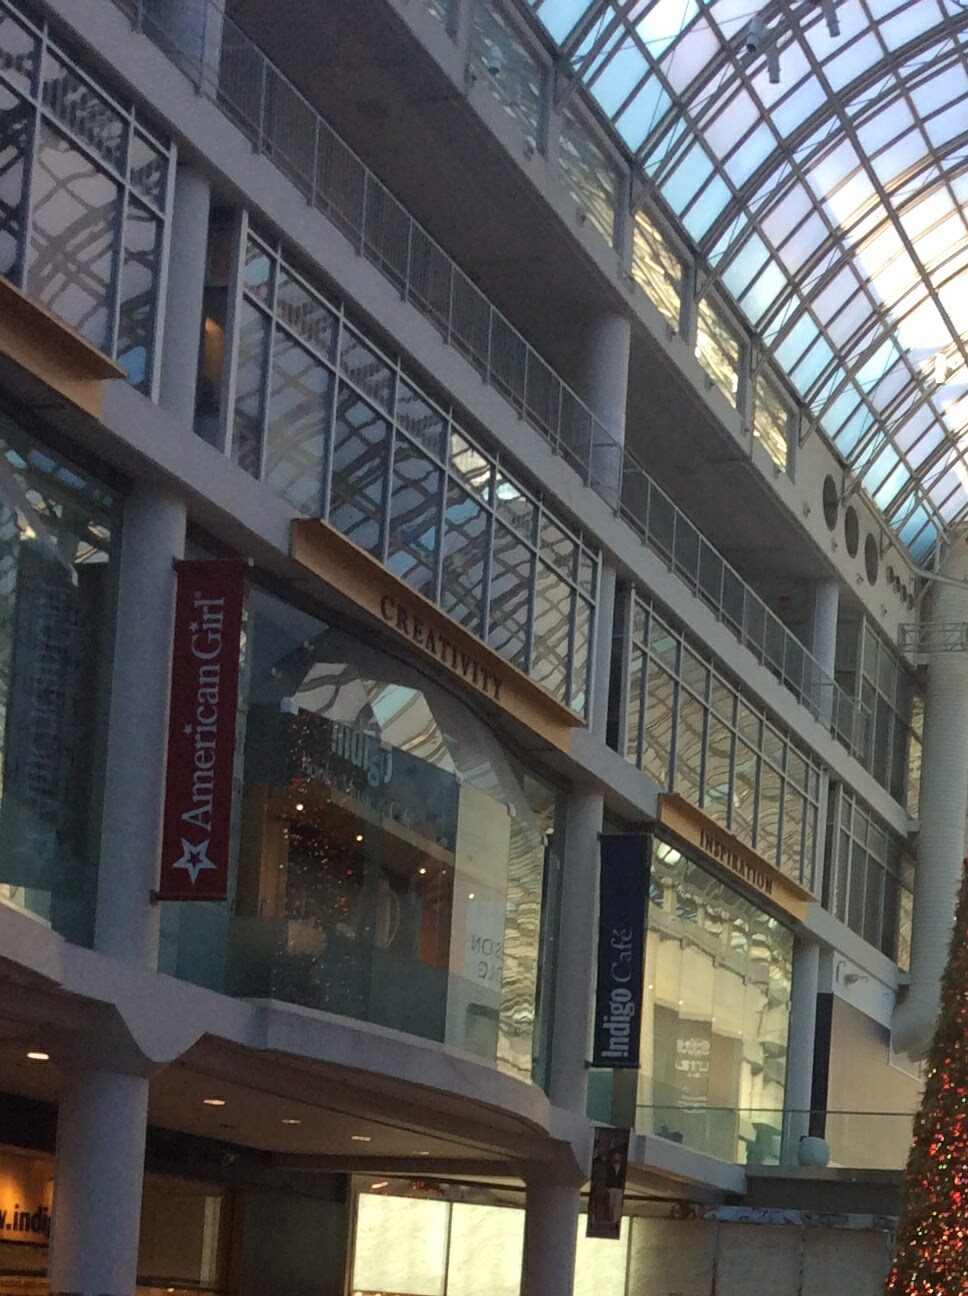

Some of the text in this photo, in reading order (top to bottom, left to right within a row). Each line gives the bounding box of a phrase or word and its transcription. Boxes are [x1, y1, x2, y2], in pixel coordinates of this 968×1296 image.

[381, 595, 502, 699] CREATIVITY
[699, 828, 773, 895] INSPIRATION
[601, 926, 635, 1058] Indigo Café
